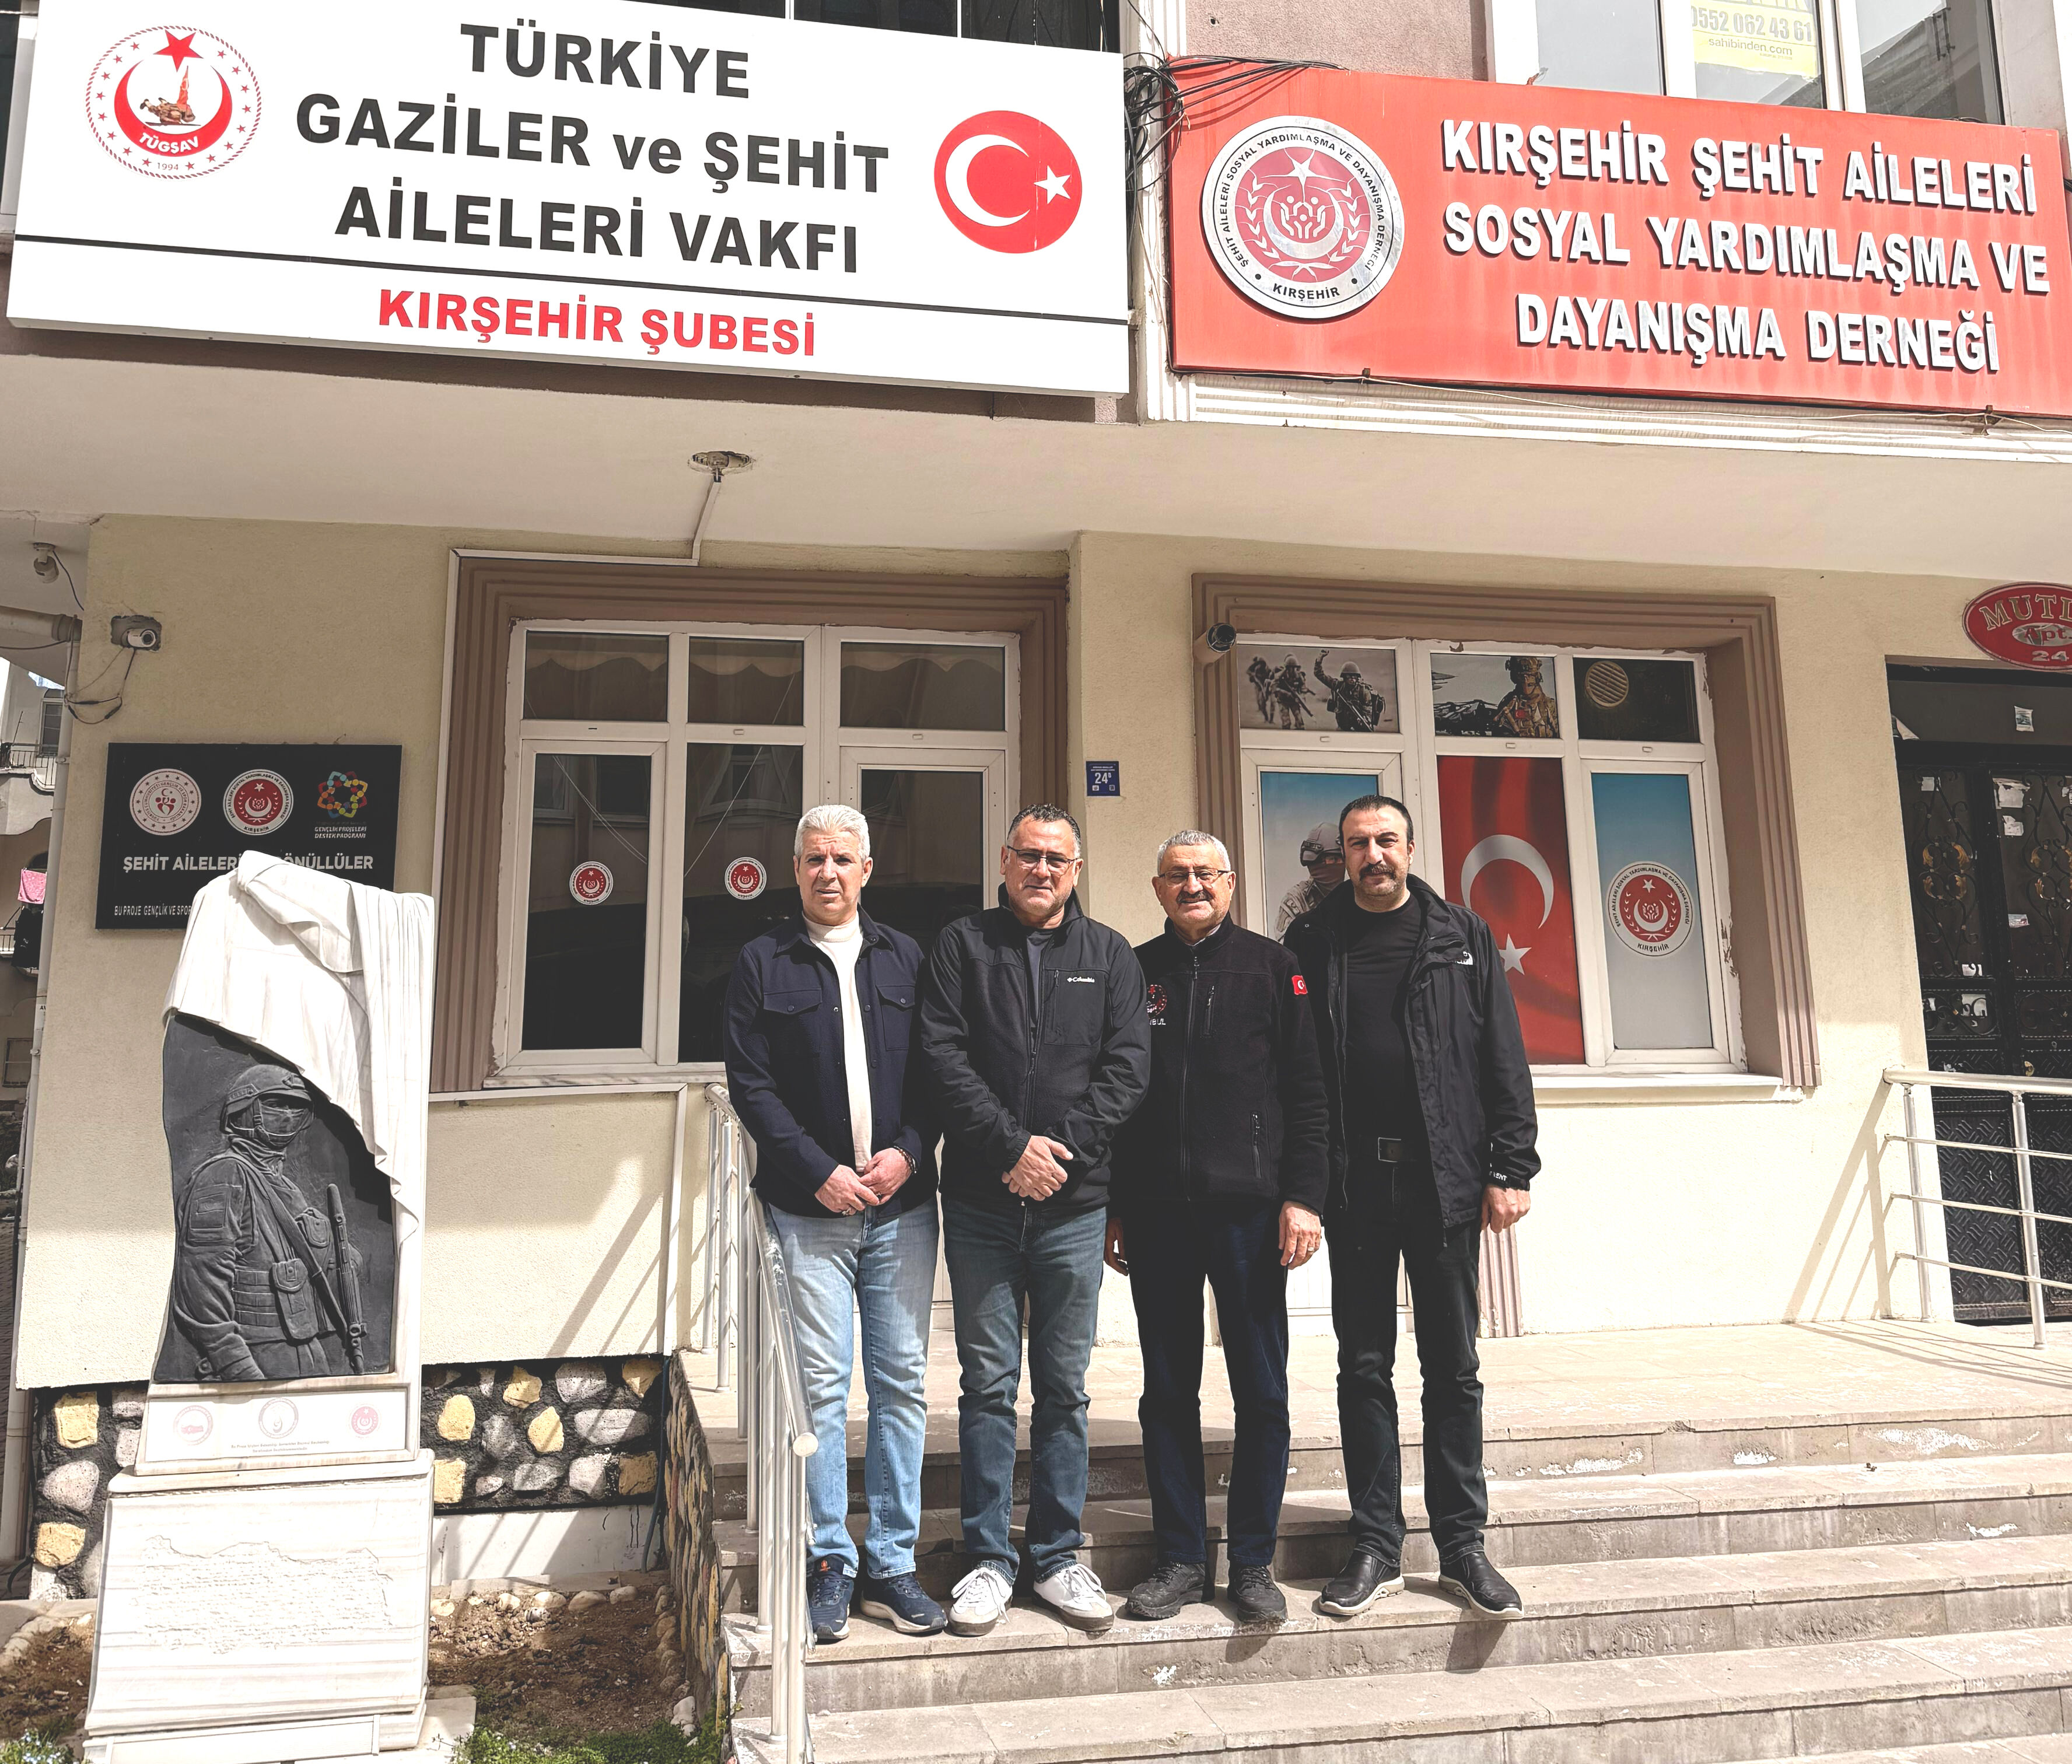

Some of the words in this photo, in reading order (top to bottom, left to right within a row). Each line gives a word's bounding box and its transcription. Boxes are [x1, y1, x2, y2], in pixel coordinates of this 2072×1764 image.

[1733, 13, 1766, 36] 062
[1769, 18, 1789, 39] 43
[1794, 20, 1812, 41] 61
[461, 19, 748, 98] TÜRKİYE
[1709, 38, 1793, 55] sahibinden.com
[297, 94, 590, 166] GAZİLER
[613, 135, 681, 173] ve
[704, 131, 888, 193] ŞEHİT
[1257, 134, 1335, 150] YARDIMLAŞMA
[1339, 149, 1352, 161] VE
[157, 162, 178, 170] 1994
[1227, 146, 1257, 181] SOSYAL
[1444, 120, 1670, 186] KIRŞEHİR
[1693, 133, 1824, 198] ŞEHİT
[1845, 141, 2037, 212] AİLELERİ
[1353, 161, 1384, 220] DAYANIŞMA
[1220, 182, 1230, 232] AİLELERİ
[335, 177, 643, 257] AİLELERİ
[670, 212, 856, 273] VAKFI
[1226, 237, 1249, 267] ŞEHİT
[1445, 202, 1630, 262] SOSYAL
[1648, 216, 1981, 293] YARDIMLAŞMA
[1991, 242, 2050, 292] VE
[1273, 283, 1340, 302] KIRŞEHİR
[380, 289, 622, 343] KIRŞEHİR
[640, 309, 814, 355] ŞUBESİ
[1518, 294, 1787, 365] DAYANIŞMA
[1807, 310, 2000, 370] DERNEĞİ
[2032, 650, 2069, 662] 24
[123, 853, 169, 873] ŞEHİT
[114, 905, 123, 916] BU
[123, 905, 141, 916] PROJE
[144, 903, 167, 918] GENÇLİK
[169, 905, 176, 915] VE
